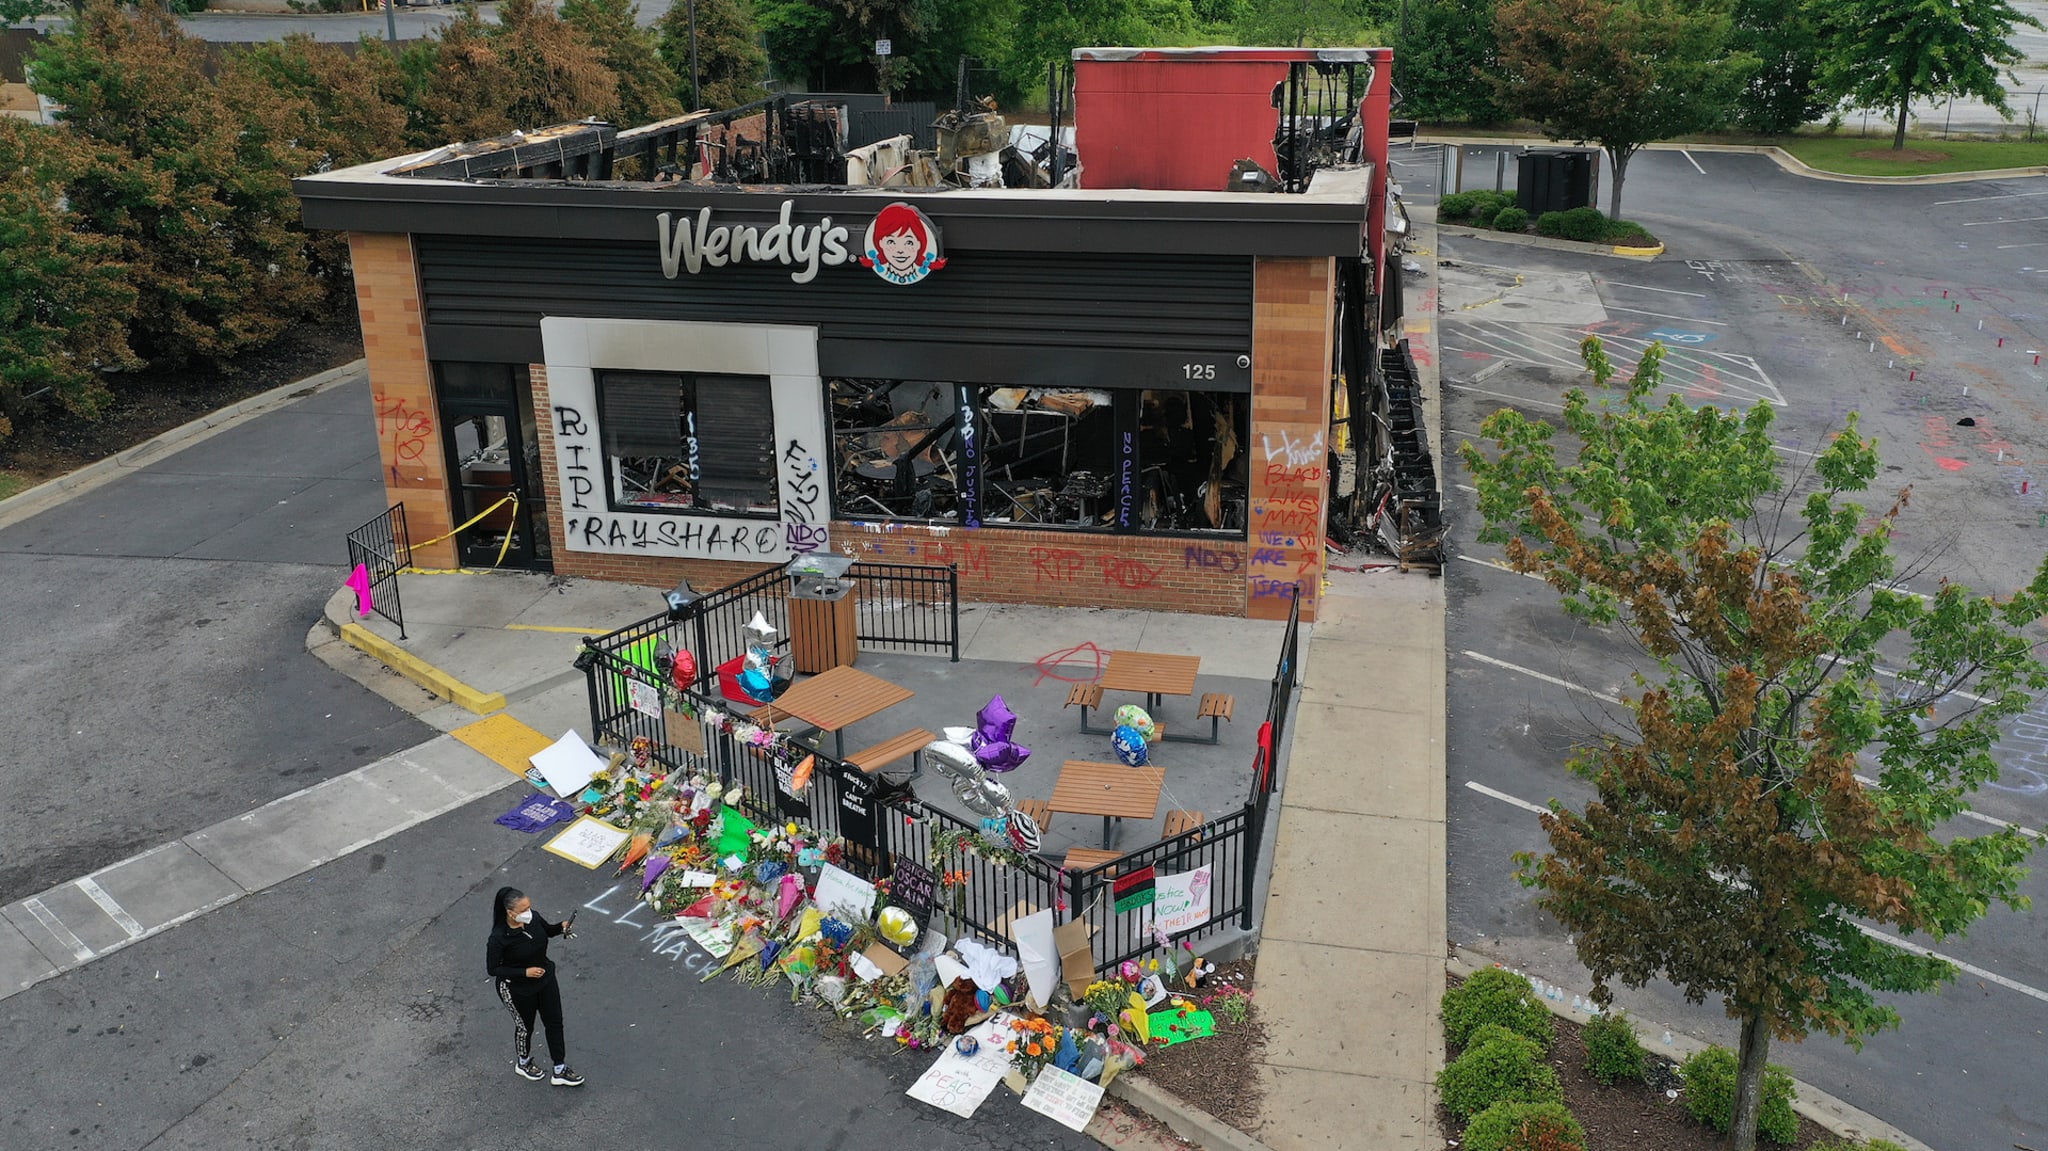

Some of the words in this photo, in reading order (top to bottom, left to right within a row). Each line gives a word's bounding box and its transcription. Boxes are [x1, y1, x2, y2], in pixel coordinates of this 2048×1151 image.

[656, 199, 849, 284] Wendy's
[1183, 364, 1217, 380] 125
[554, 406, 594, 509] RIP
[1268, 482, 1320, 514] LIVES
[786, 522, 828, 544] NDO
[1258, 530, 1284, 546] WE
[1029, 546, 1085, 583] RIP
[1252, 548, 1288, 567] ARE
[899, 859, 927, 880] JUSTICE
[896, 868, 932, 899] OSCAR
[896, 884, 926, 908] CAIN
[1164, 911, 1193, 930] THEIR
[925, 1069, 985, 1098] PEACE
